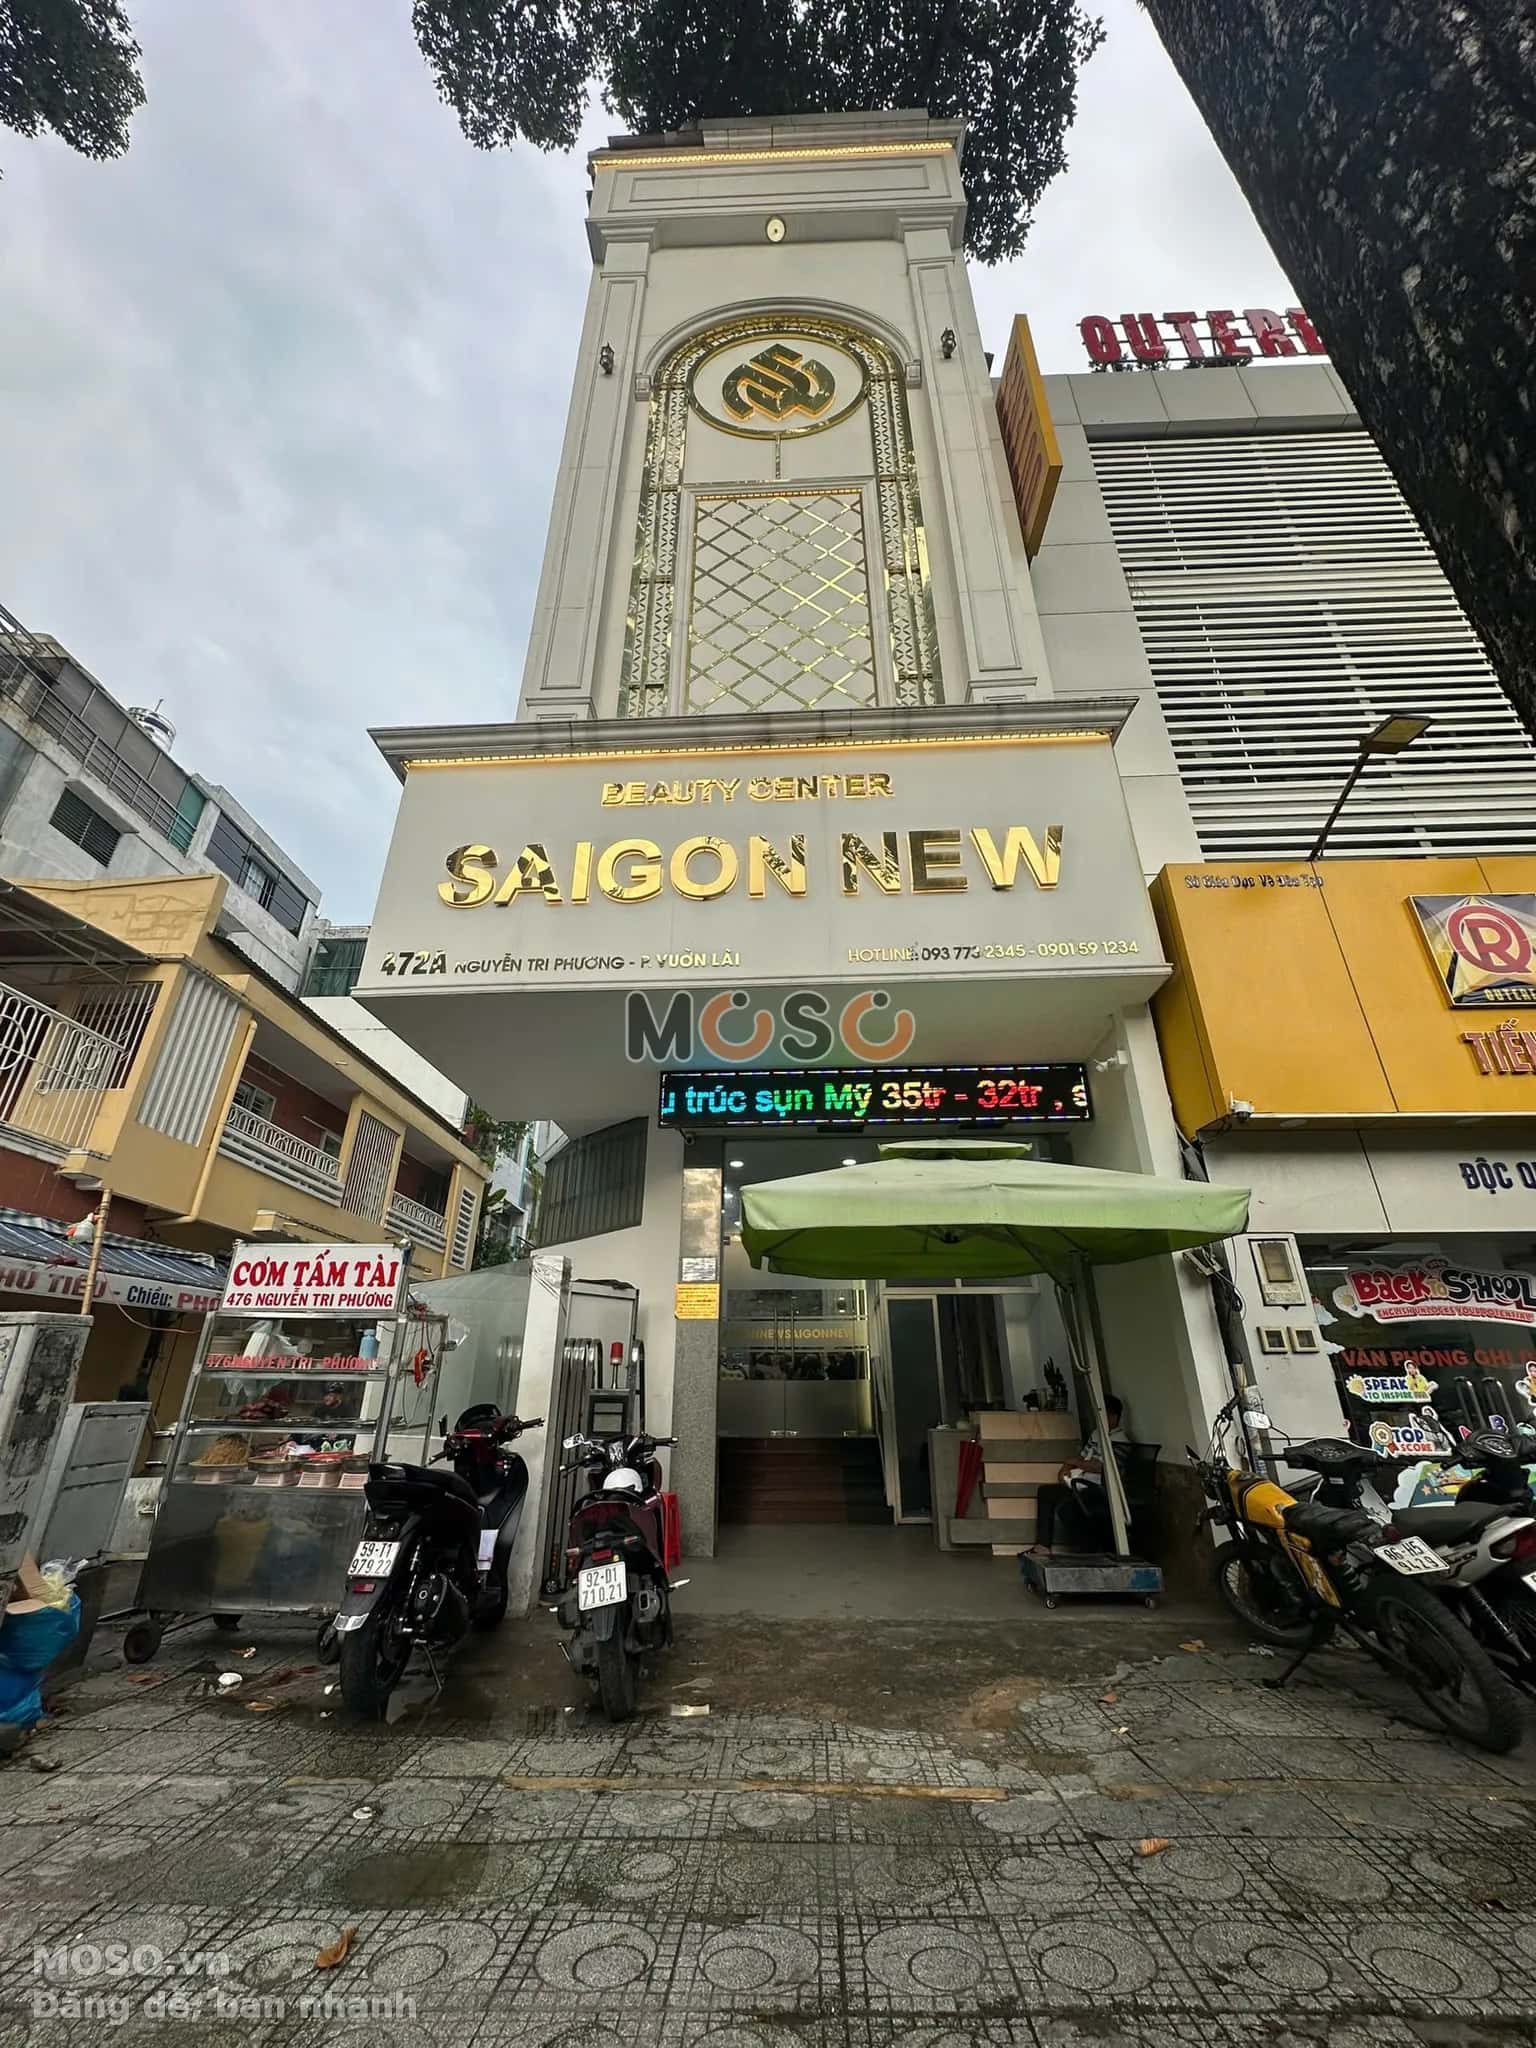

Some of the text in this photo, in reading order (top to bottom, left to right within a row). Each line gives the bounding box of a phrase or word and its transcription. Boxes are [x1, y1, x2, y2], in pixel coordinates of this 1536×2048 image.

[601, 772, 896, 806] BEAUTY CENTER
[437, 824, 1065, 909] SAIGON NEW
[921, 947, 950, 961] 093
[954, 946, 980, 960] 773
[984, 944, 1026, 959] 2345
[1037, 942, 1074, 957] 0901
[1078, 942, 1098, 956] 59
[1102, 940, 1139, 955] 1234
[381, 951, 447, 976] 472A
[454, 953, 522, 974] NGUYỄN
[527, 958, 549, 971] TRI
[881, 1080, 944, 1110] 35tr
[976, 1078, 1043, 1109] 32tr
[233, 1249, 400, 1287] CƠM TẤM TÀI
[227, 1293, 252, 1306] 476
[313, 1294, 335, 1307] TRI
[338, 1291, 393, 1308] PHƯƠNG
[1365, 1379, 1409, 1391] SPEAK
[1368, 1391, 1380, 1399] TO
[1392, 1429, 1424, 1443] TOP
[1400, 1443, 1433, 1452] SCORE
[360, 1542, 392, 1557] 59-T1
[586, 1567, 618, 1588] 92-D1
